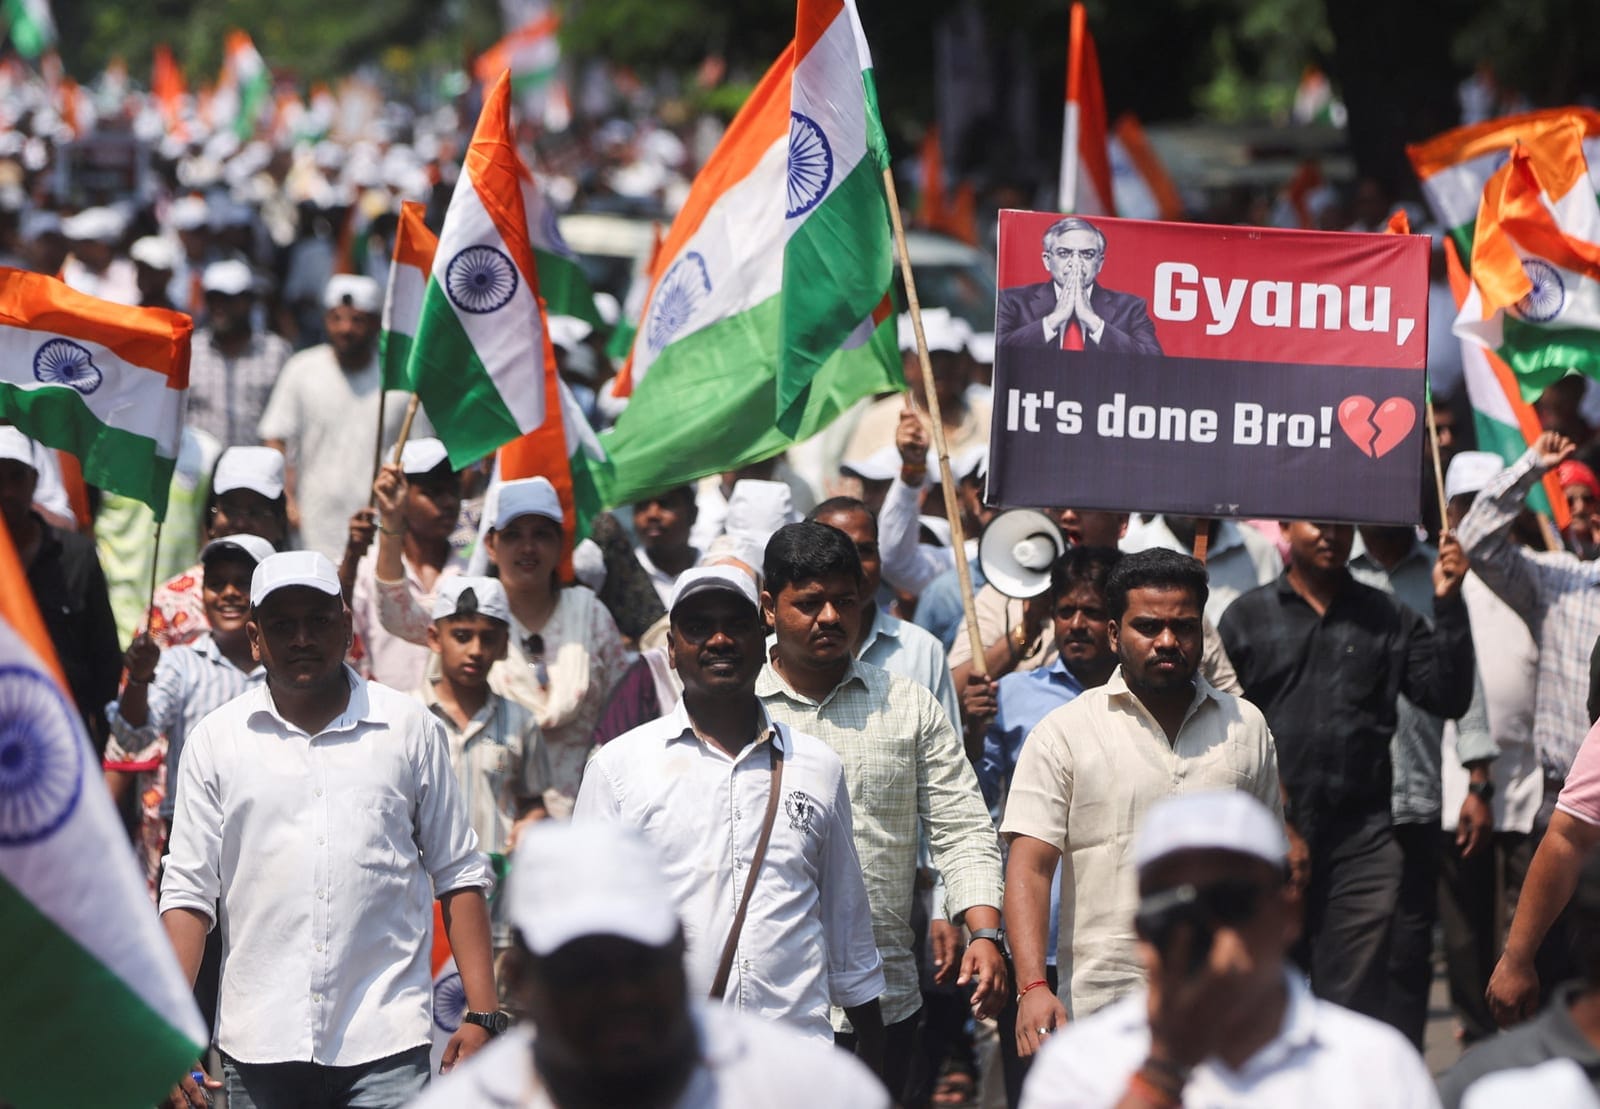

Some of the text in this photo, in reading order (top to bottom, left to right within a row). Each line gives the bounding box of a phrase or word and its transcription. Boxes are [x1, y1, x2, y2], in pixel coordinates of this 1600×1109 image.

[1152, 261, 1415, 346] Gyanu,
[1007, 389, 1333, 448] It's done Bro!
